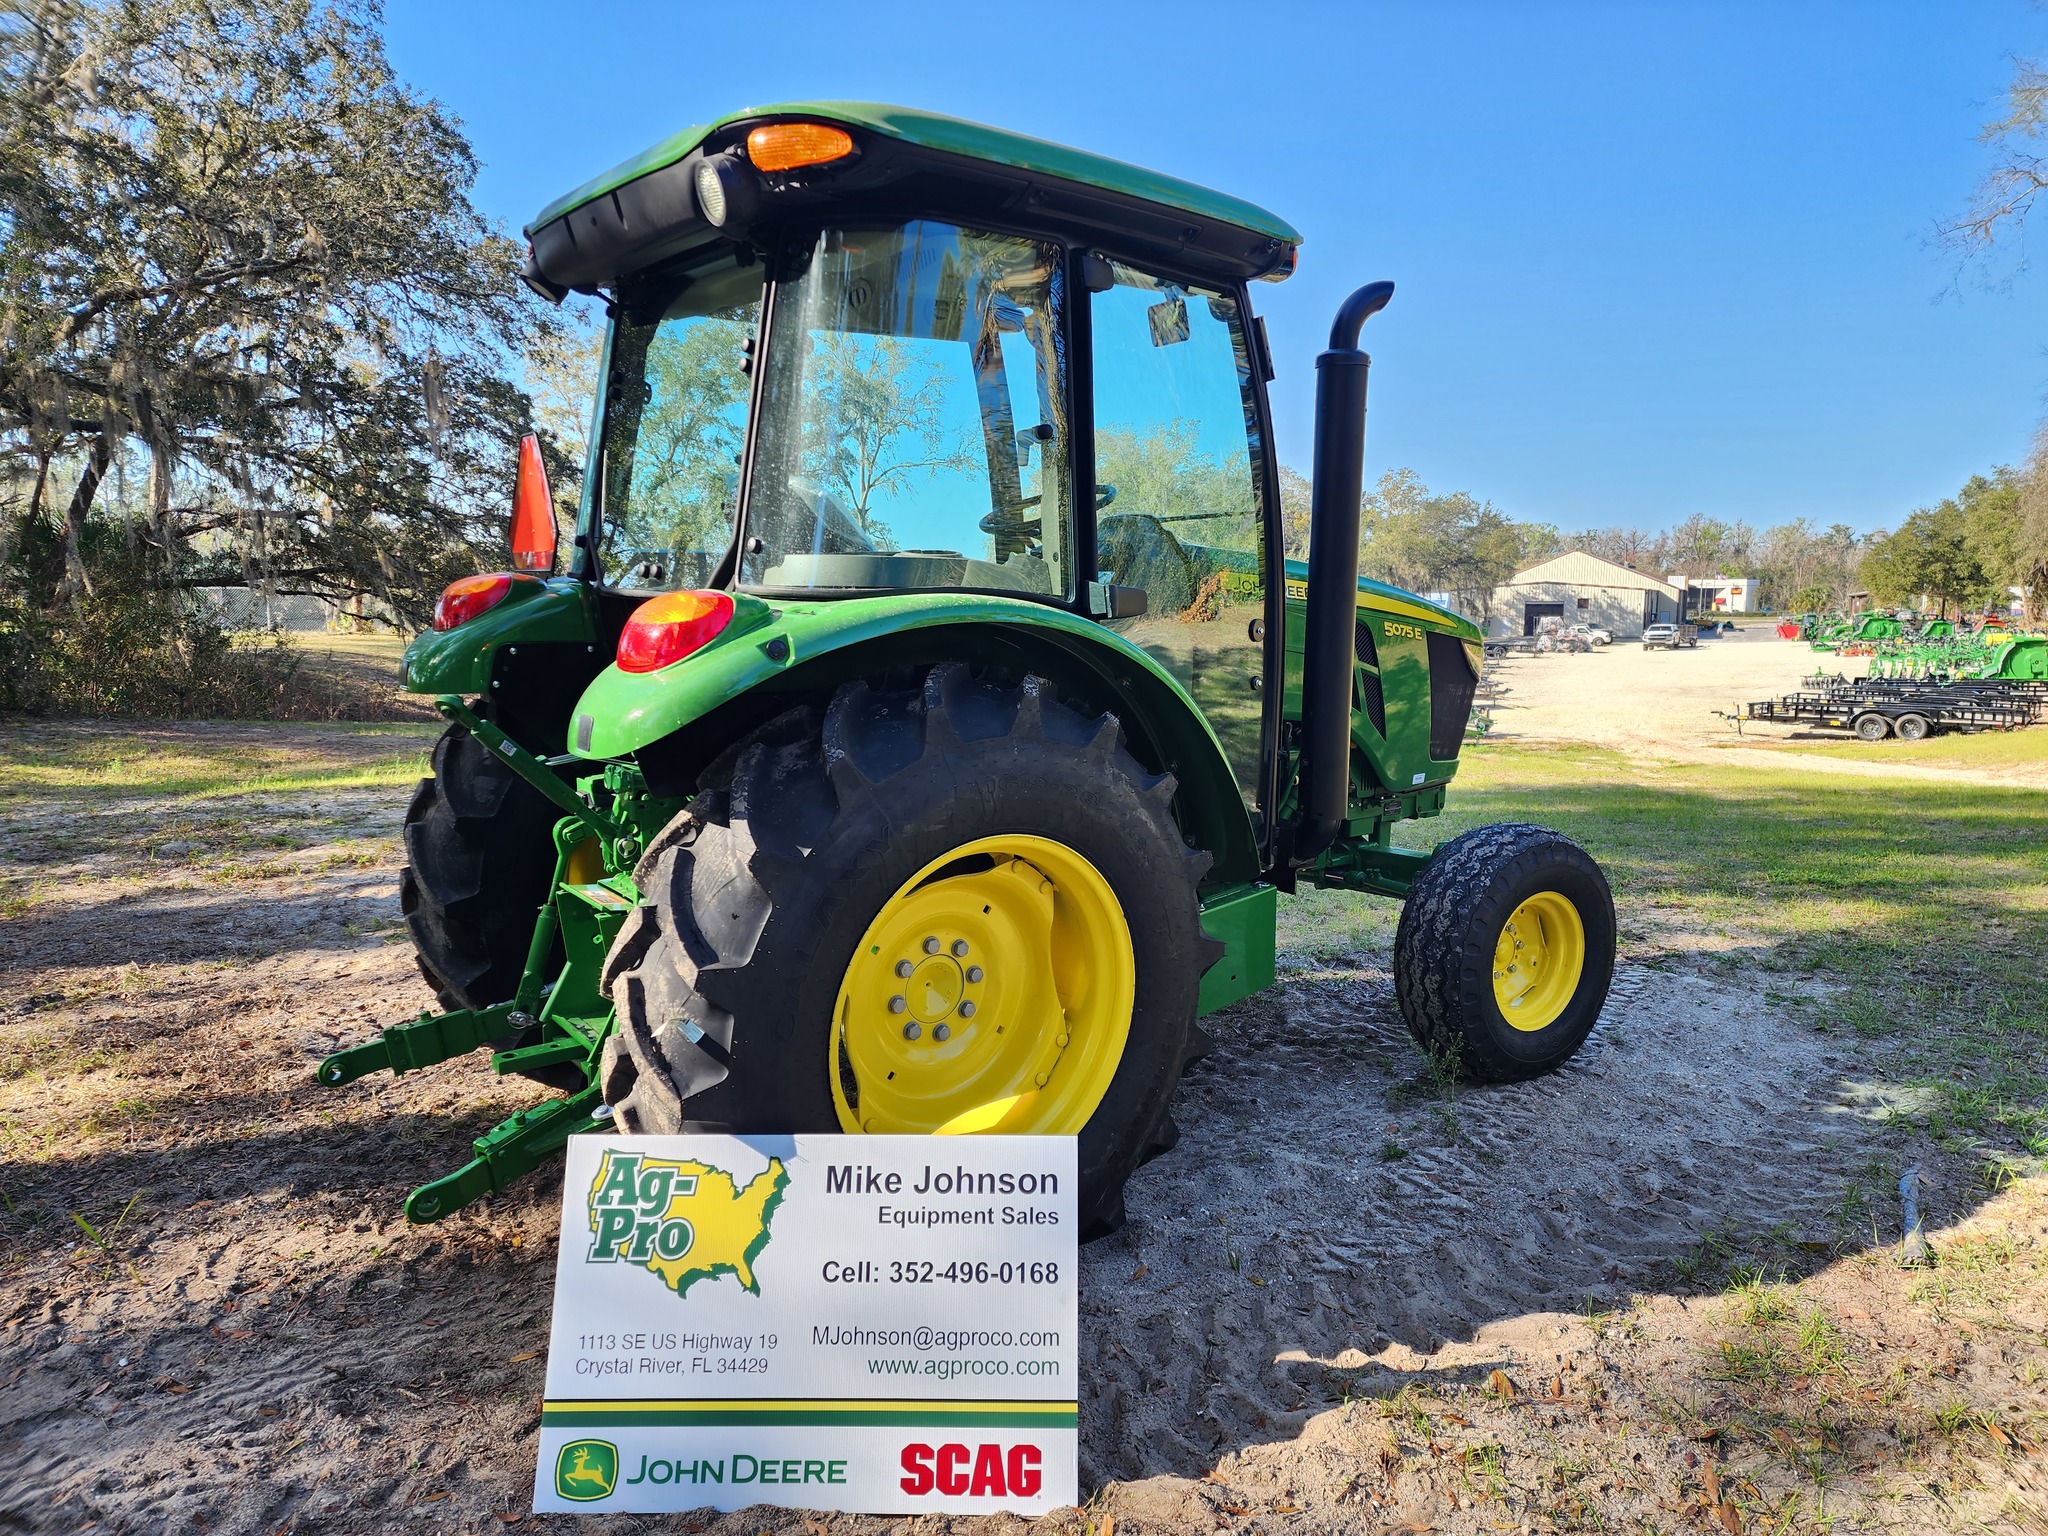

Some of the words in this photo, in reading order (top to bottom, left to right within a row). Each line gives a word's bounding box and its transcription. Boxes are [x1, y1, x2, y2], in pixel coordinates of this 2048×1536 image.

[1384, 621, 1414, 638] 5075
[593, 1153, 698, 1219] Ag-
[825, 1165, 903, 1195] Mike
[913, 1165, 1059, 1195] Johnson
[878, 1206, 995, 1229] Equipment
[1001, 1206, 1060, 1226] Sales
[587, 1208, 695, 1262] Pro
[822, 1260, 880, 1284] Cell:
[889, 1260, 1060, 1284] 352-496-0168
[579, 1333, 616, 1351] 1113
[621, 1333, 647, 1350] SE
[652, 1333, 677, 1350] US
[682, 1333, 753, 1354] Highway
[759, 1333, 778, 1350] 19
[812, 1325, 1060, 1352] MJohnson@agproco.com
[575, 1357, 634, 1379] Crystal
[639, 1357, 685, 1376] River,
[691, 1357, 713, 1373] FL
[716, 1357, 768, 1374] 34429
[867, 1359, 1060, 1380] www.agproco.com
[626, 1454, 724, 1485] JOHN
[731, 1454, 848, 1484] DEERE
[899, 1442, 1043, 1498] SCAG
